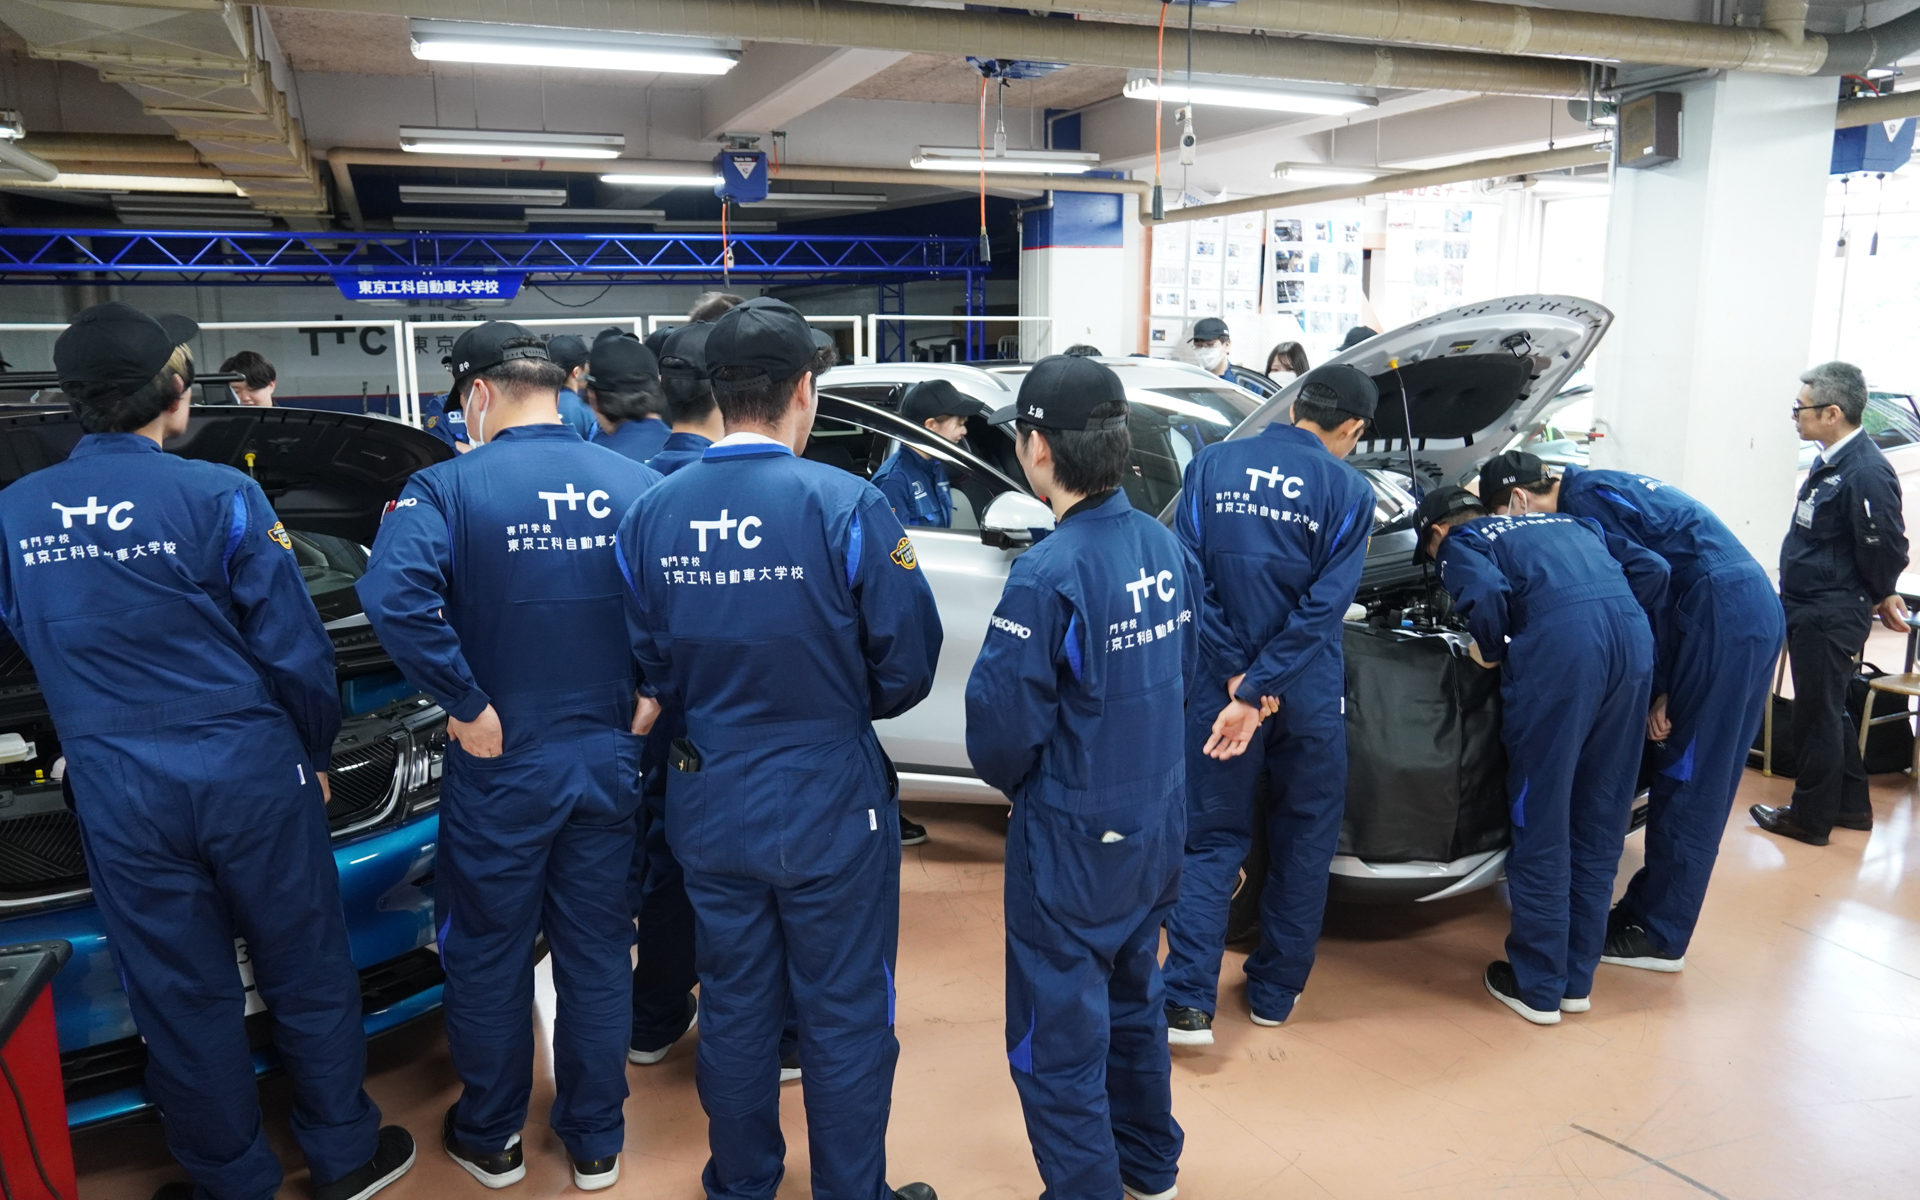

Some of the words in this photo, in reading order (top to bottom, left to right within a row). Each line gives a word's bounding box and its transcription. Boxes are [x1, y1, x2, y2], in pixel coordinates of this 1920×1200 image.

[358, 280, 499, 295] 東京工科自動車大学校
[1215, 491, 1251, 502] 専門学校
[506, 523, 552, 536] 専門学校
[19, 533, 71, 550] 専門学校
[22, 540, 178, 567] 東京工科自車大学校
[659, 556, 701, 568] 専門学校
[991, 614, 1032, 640] RECARO
[1106, 618, 1138, 636] 門学校
